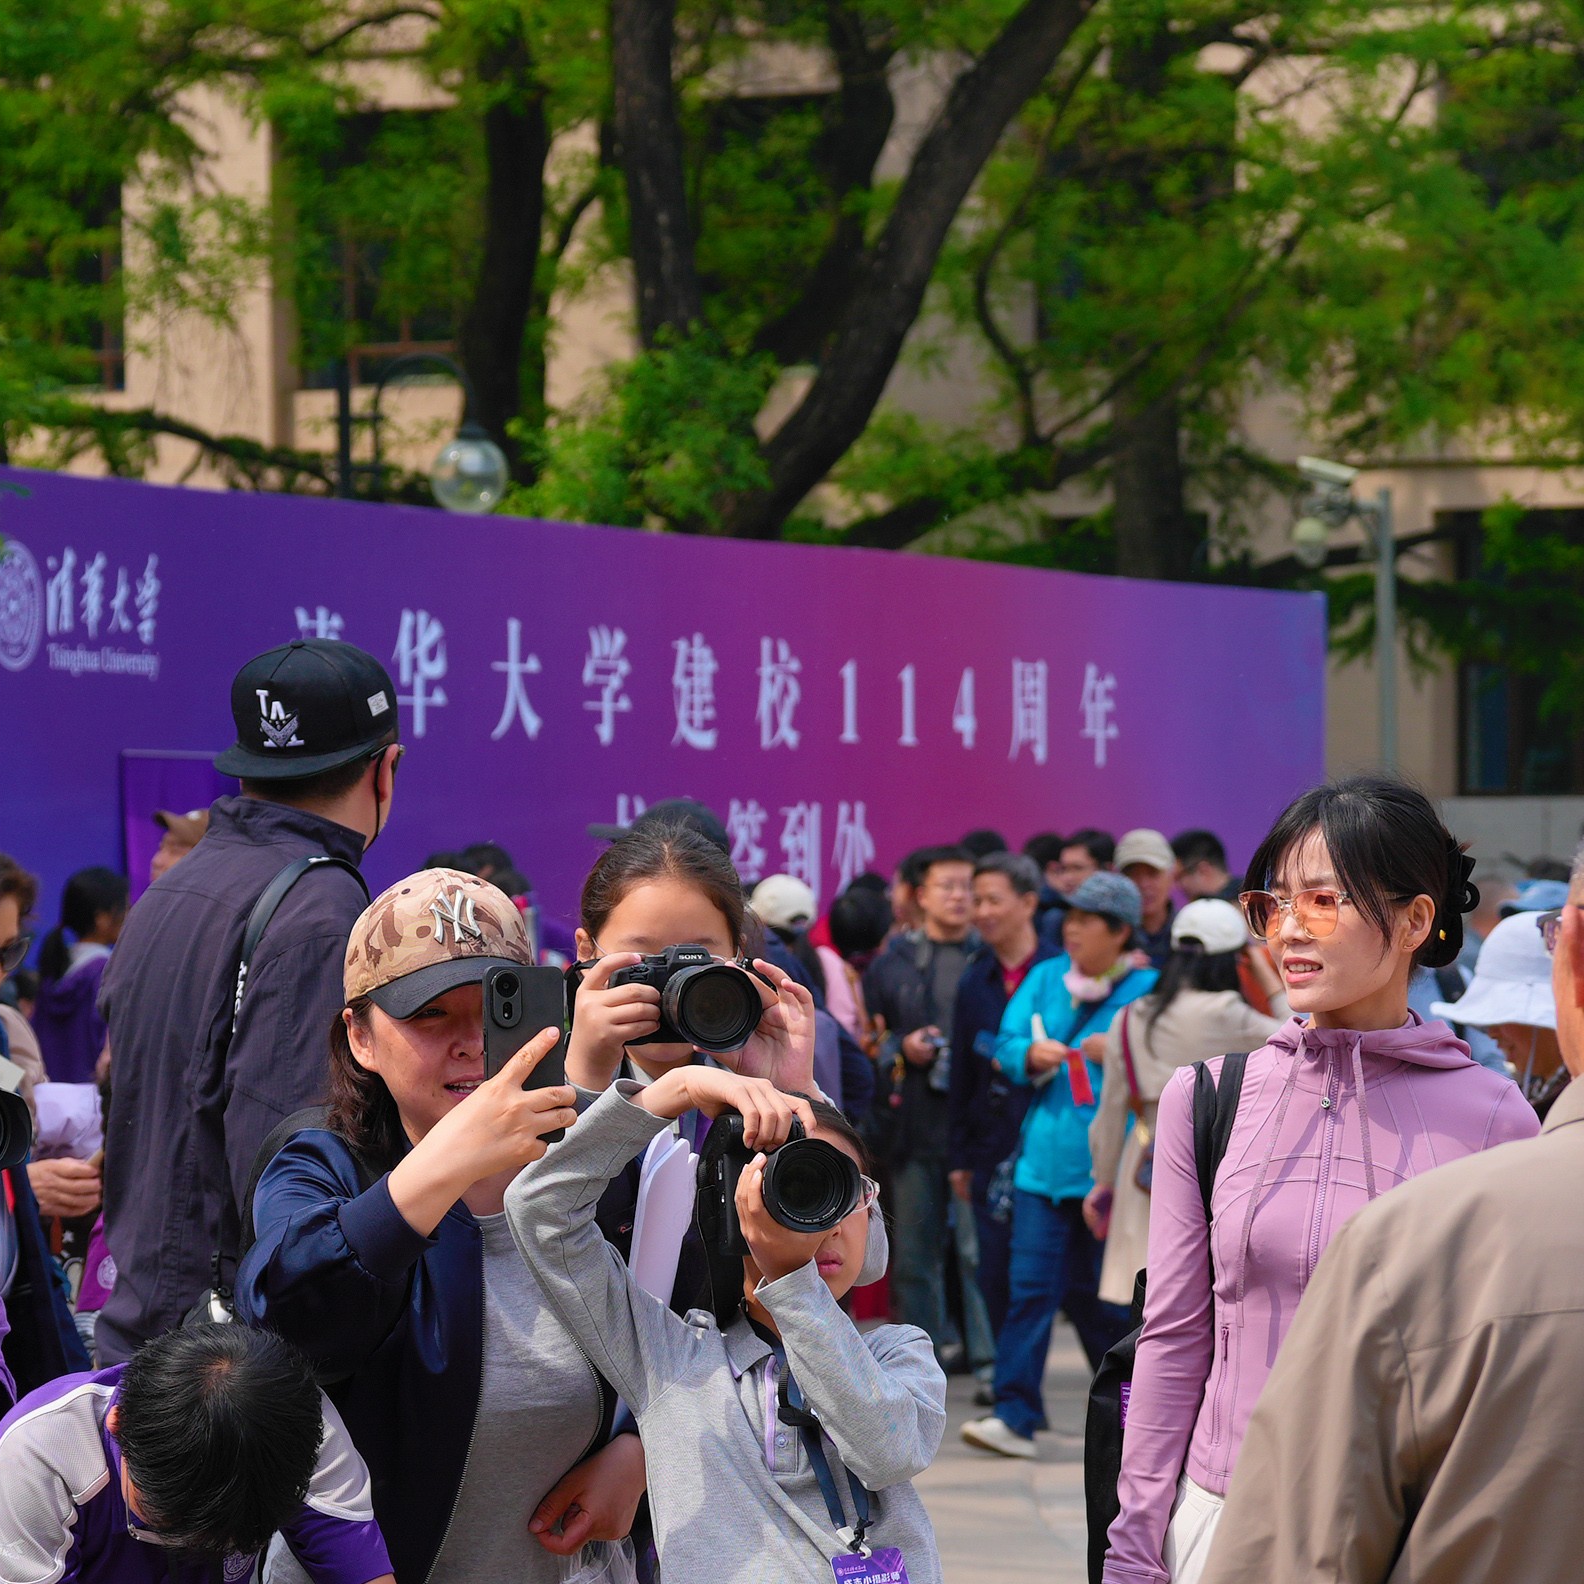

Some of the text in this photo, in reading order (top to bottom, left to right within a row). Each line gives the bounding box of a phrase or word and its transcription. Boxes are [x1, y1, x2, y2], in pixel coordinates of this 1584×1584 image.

[46, 643, 162, 682] Tsinghua University
[429, 889, 482, 943] NY
[678, 953, 703, 961] SONY
[232, 961, 247, 1033] ONY
